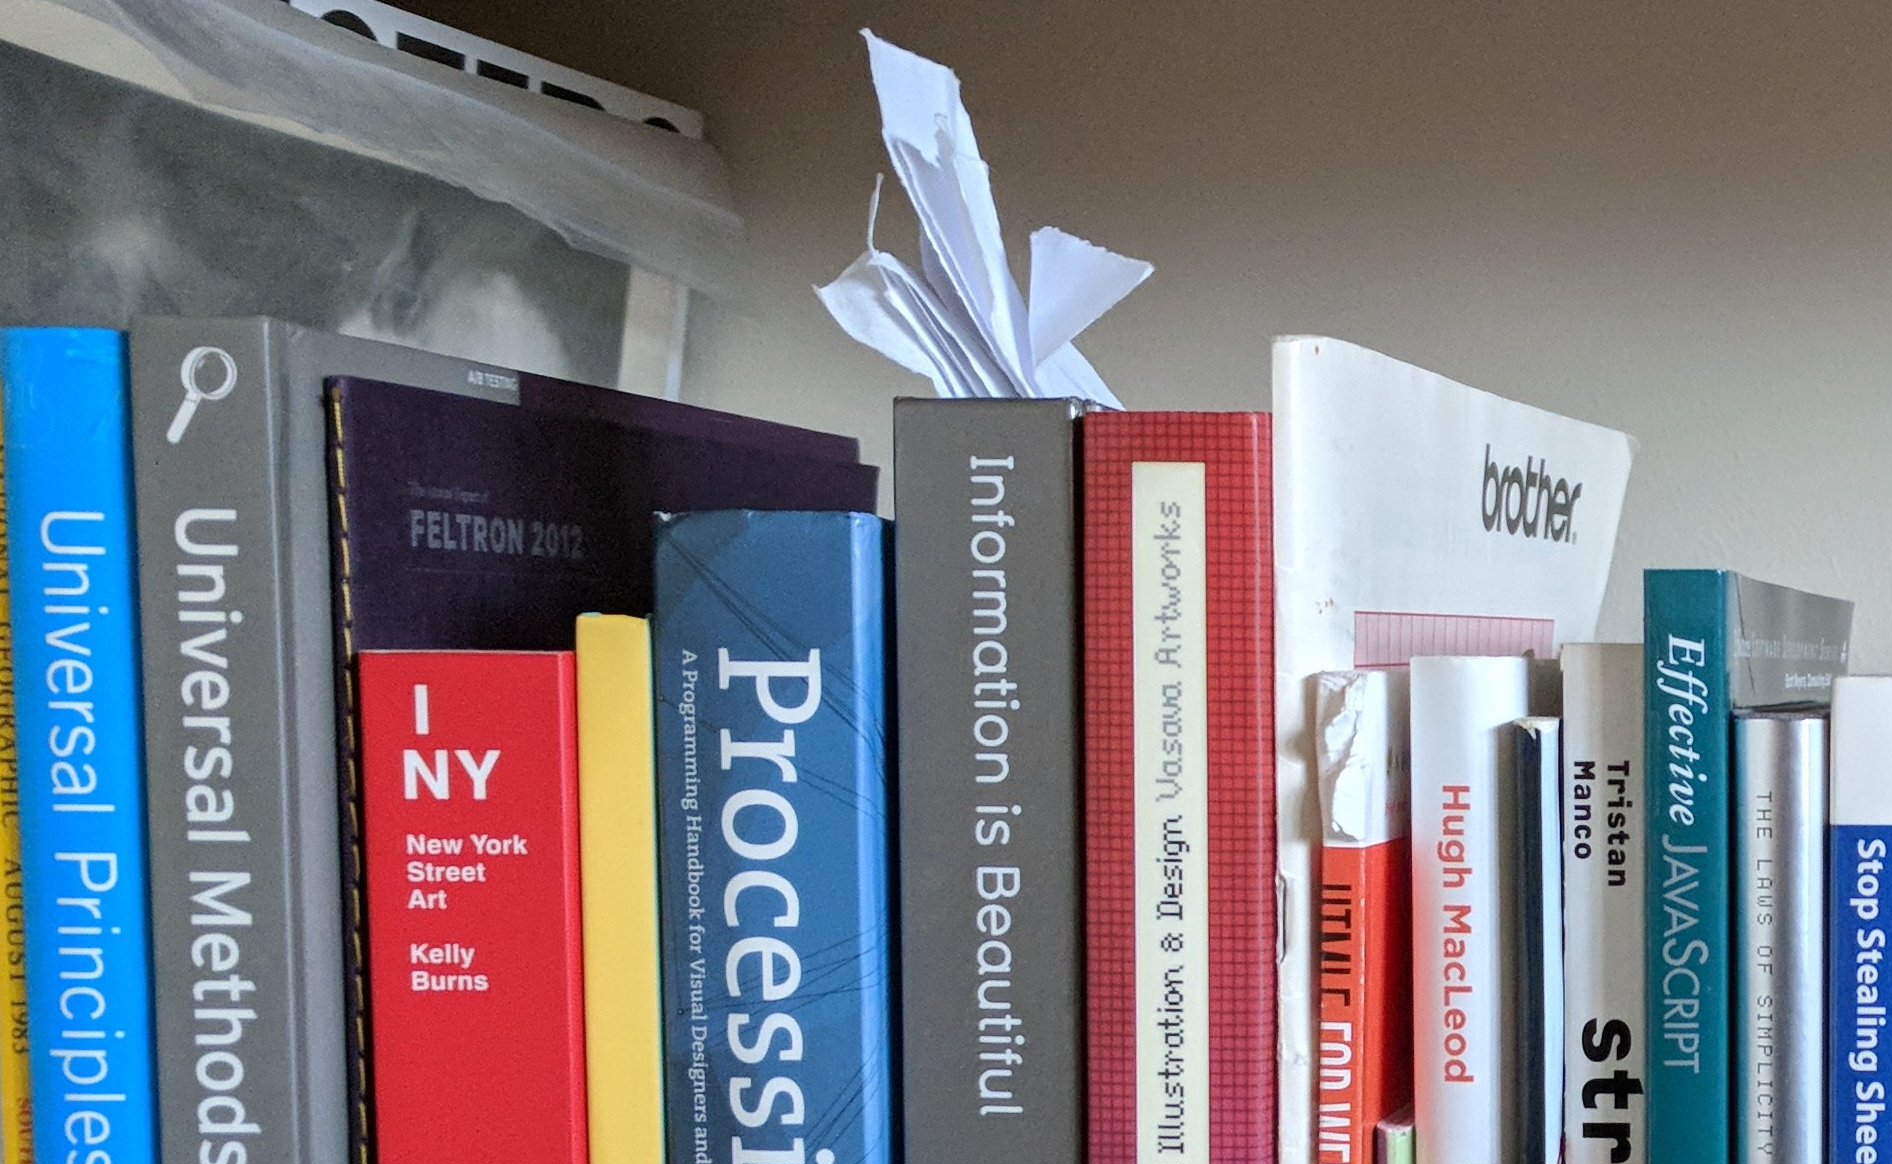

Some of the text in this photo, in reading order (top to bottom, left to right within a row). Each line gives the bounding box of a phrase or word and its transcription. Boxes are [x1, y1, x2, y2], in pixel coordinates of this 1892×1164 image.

[409, 509, 585, 558] FELTRON 2012
[1482, 443, 1584, 545] brother
[1154, 500, 1183, 669] Artworks
[40, 510, 115, 813] Universal
[174, 508, 251, 842] Universal
[677, 670, 700, 810] Programming
[969, 455, 1025, 1117] Information Beautiful
[1155, 679, 1184, 803] Vasava
[406, 834, 528, 855] New York
[1573, 761, 1596, 860] Manco
[1607, 760, 1633, 887] Tristan
[1656, 633, 1709, 1074] Effective JAVASCRIPT
[4, 857, 26, 985] AUGUST
[406, 861, 487, 883] Street
[408, 888, 448, 909] Art
[685, 815, 706, 922] Handbook
[1156, 814, 1190, 921] Design
[1849, 838, 1887, 921] Stop
[409, 943, 476, 969] Kelly
[410, 970, 489, 991] Burns
[1437, 785, 1474, 1083] Hugh MacLeod
[1756, 791, 1775, 1157] THE LAWS SIMPLICITY
[689, 955, 708, 1023] Visual
[1848, 928, 1887, 1073] Stealing
[688, 1024, 710, 1126] Designers
[1157, 964, 1186, 1155] Illustration
[693, 1128, 711, 1164] and
